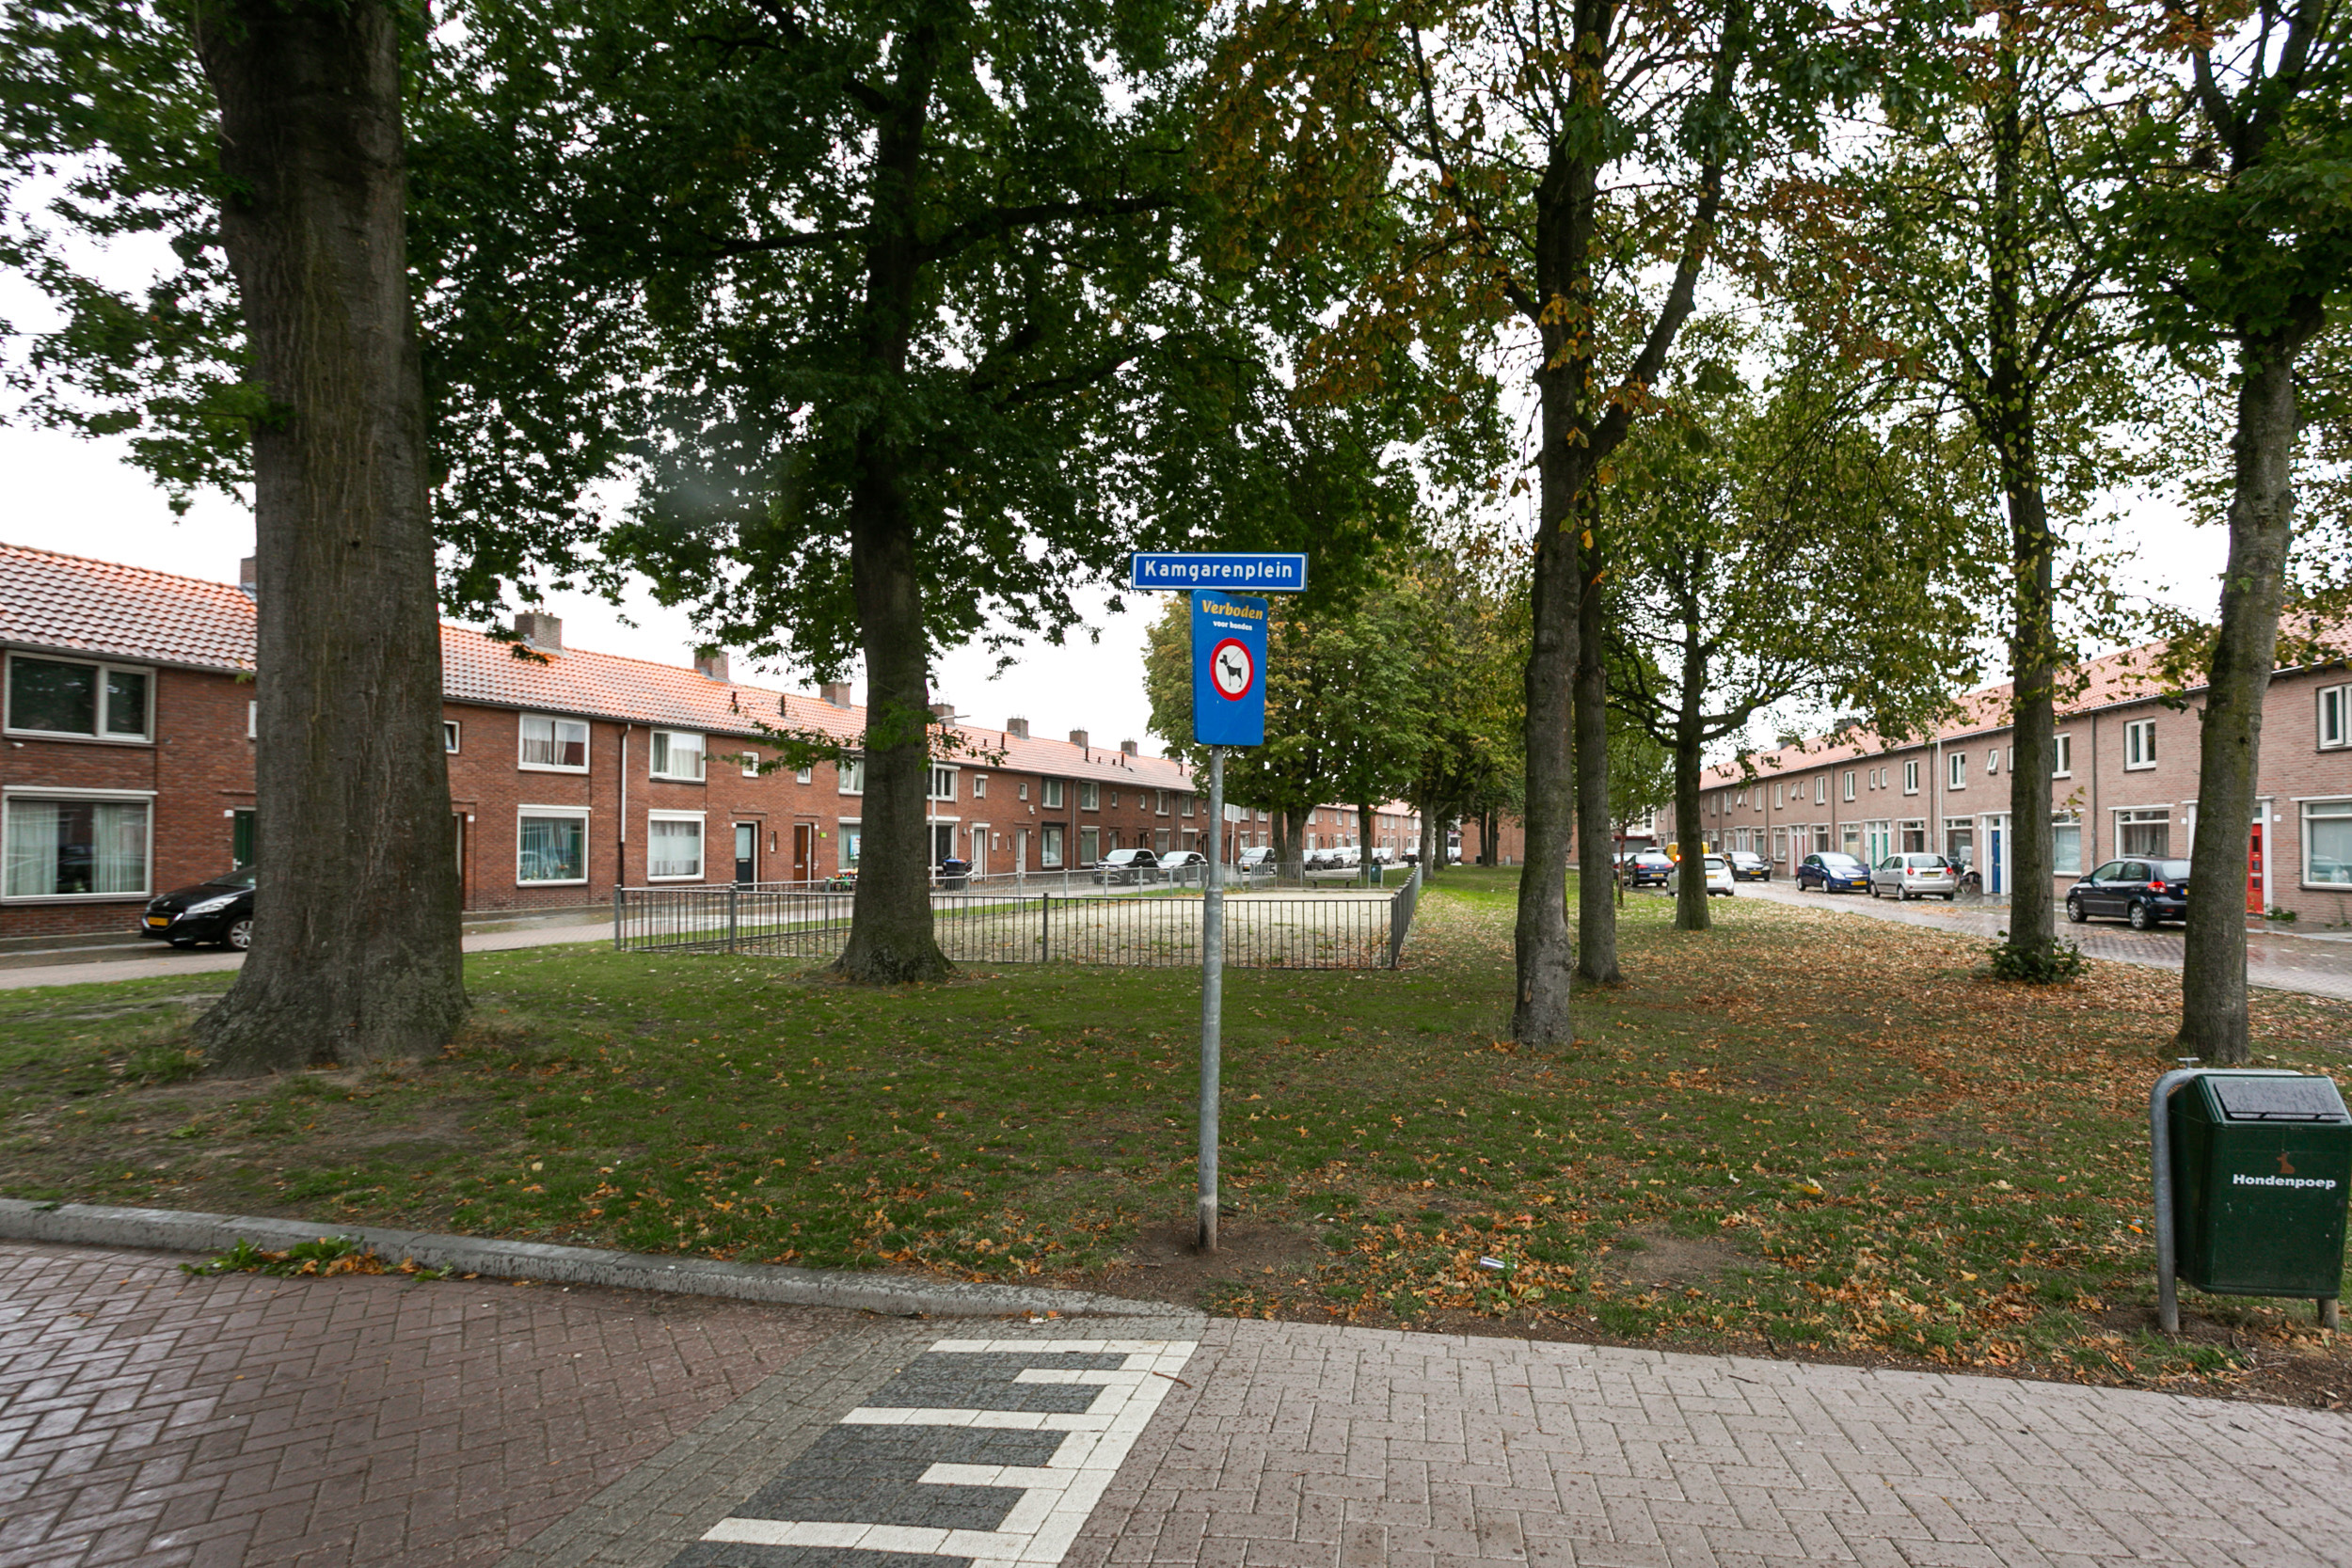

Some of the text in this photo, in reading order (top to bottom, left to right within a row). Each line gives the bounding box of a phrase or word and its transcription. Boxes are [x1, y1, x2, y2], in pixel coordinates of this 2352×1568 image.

[1144, 561, 1293, 581] Kamgarenplein
[1201, 599, 1263, 621] Verboden
[1230, 621, 1252, 631] honden
[2233, 1174, 2337, 1190] Hondenpoep
